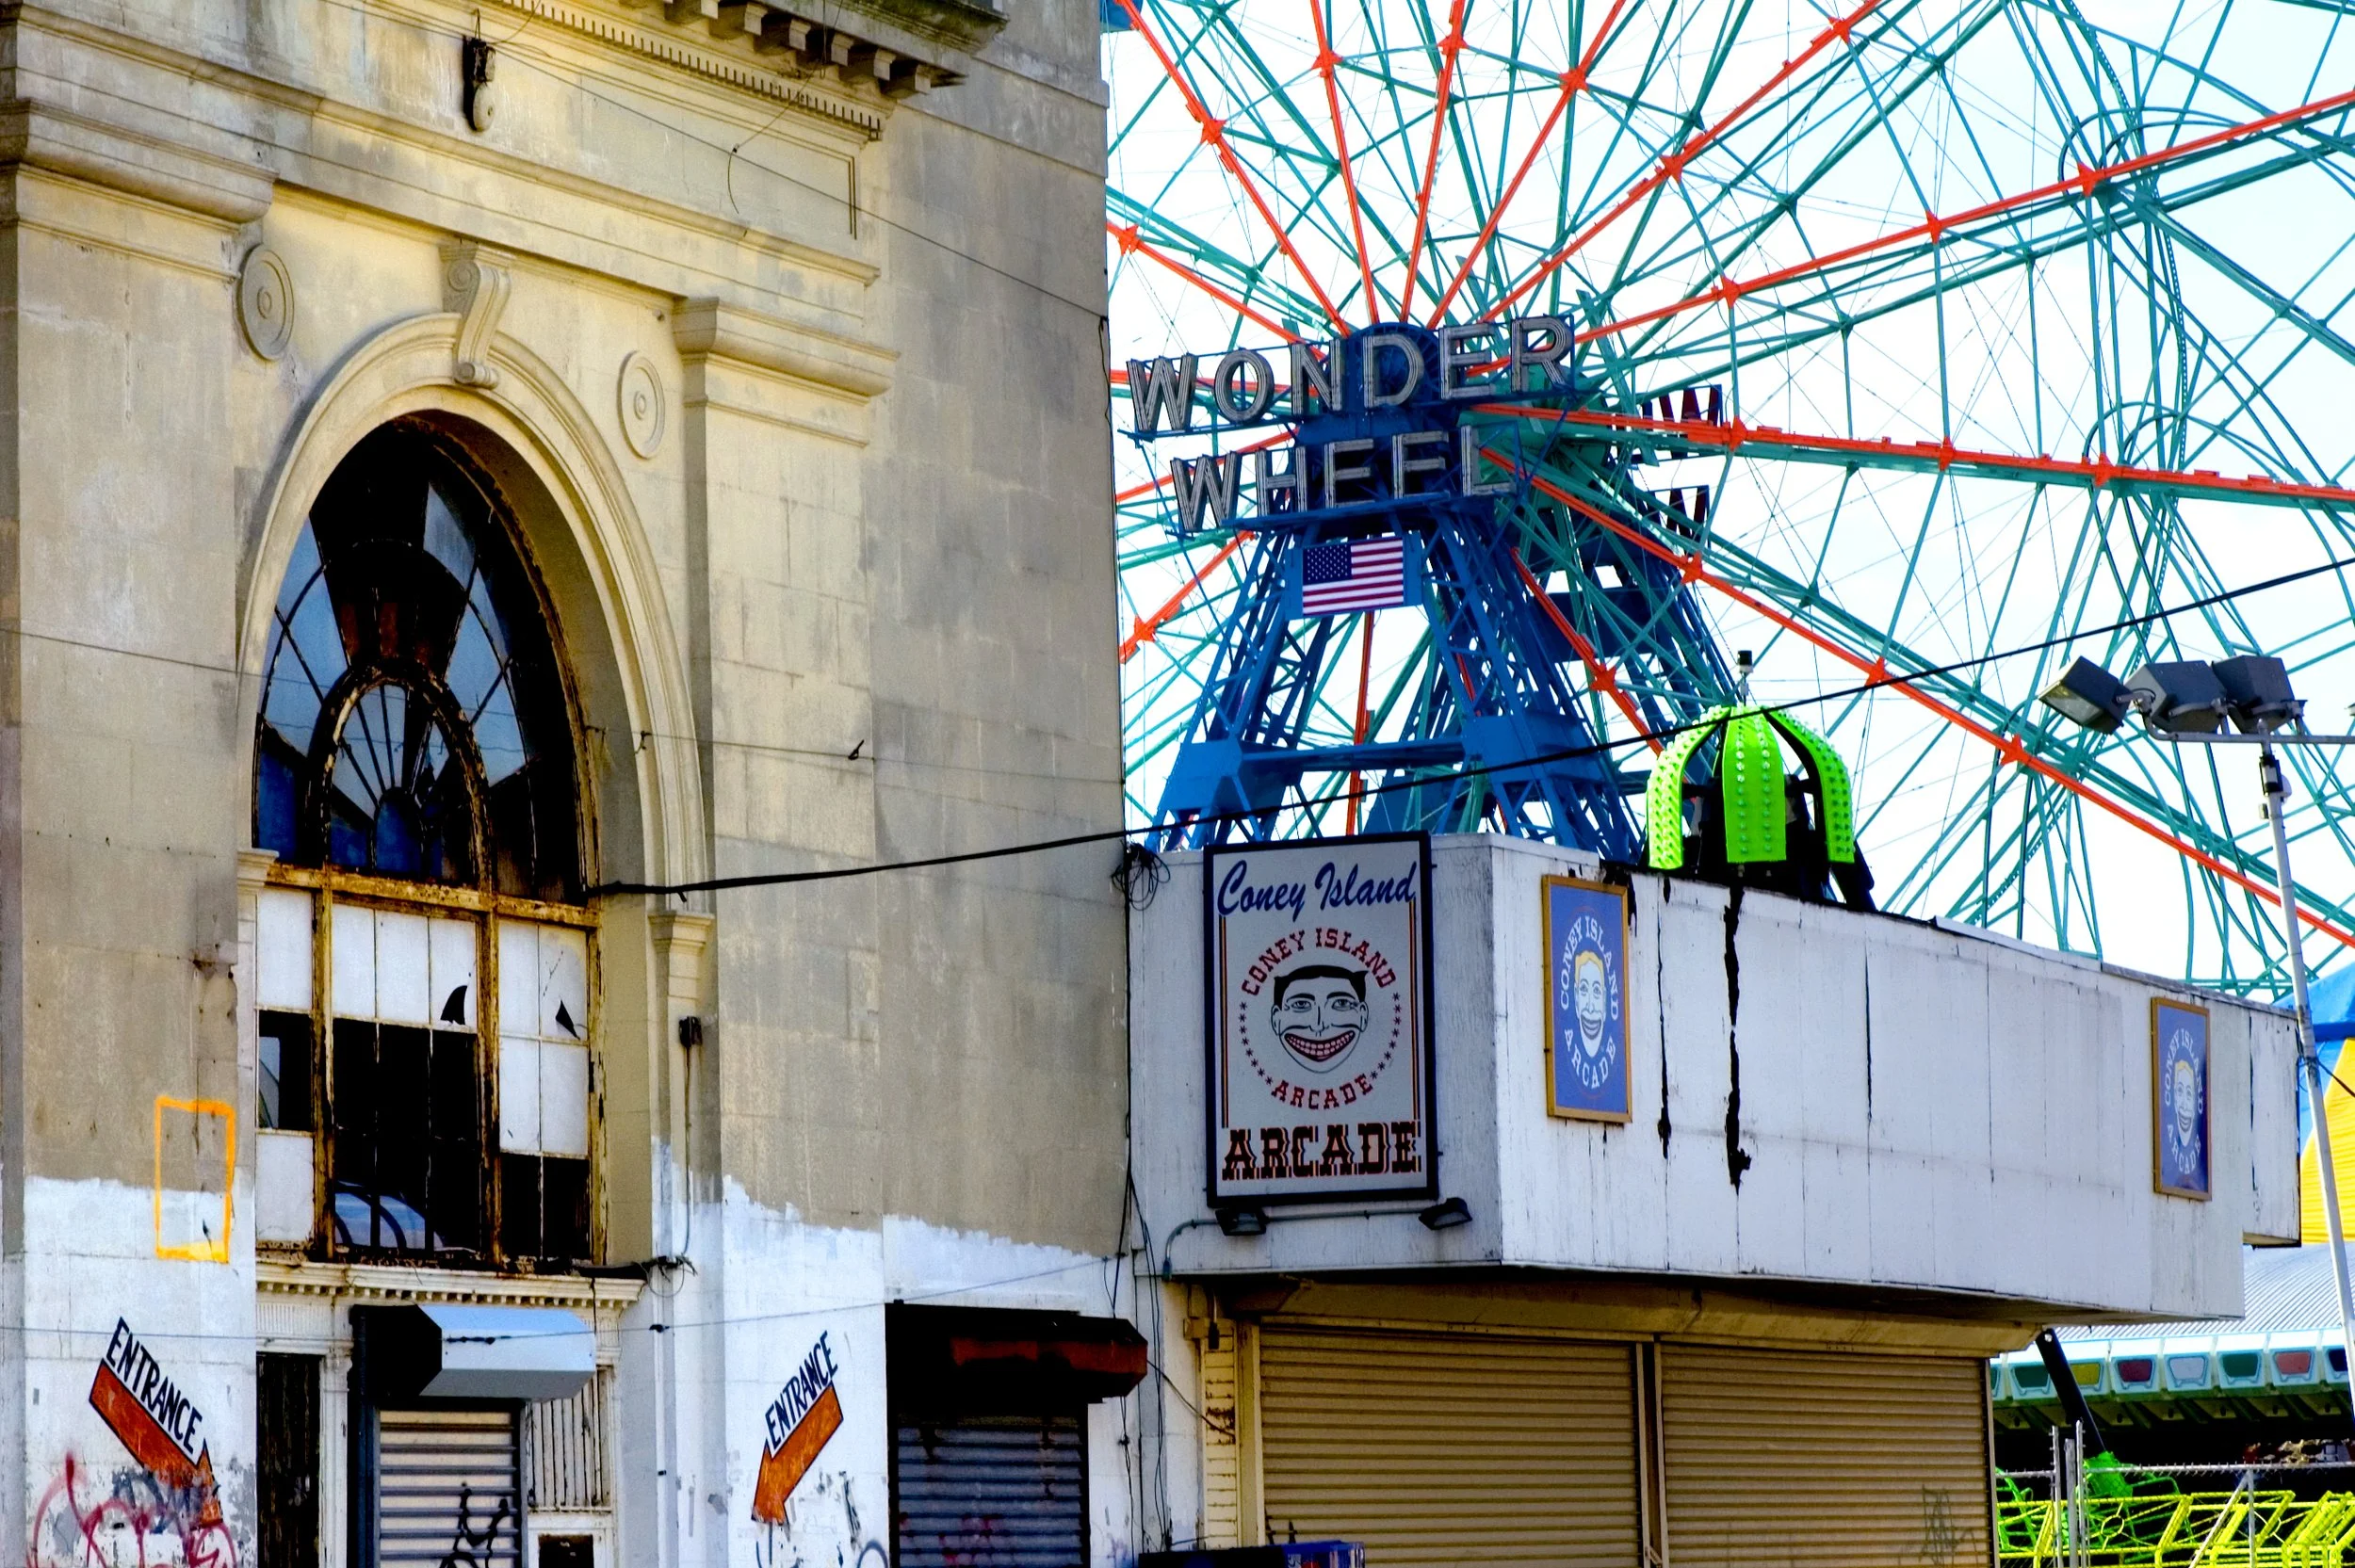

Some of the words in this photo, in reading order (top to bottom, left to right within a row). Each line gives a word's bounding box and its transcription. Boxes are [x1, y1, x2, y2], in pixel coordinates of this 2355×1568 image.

[1126, 316, 1574, 433] WONDER
[1170, 425, 1519, 532] WHEEL
[1217, 860, 1307, 922] Coney
[1314, 861, 1417, 911] Island
[1241, 929, 1306, 996] CONEY
[1315, 927, 1398, 990] ISLAND
[1560, 916, 1584, 1010] CONEY
[1585, 915, 1619, 1021] ISLAND
[1270, 1073, 1373, 1110] ARCADE
[1564, 1027, 1616, 1090] ARCADE
[2165, 1029, 2180, 1106] CONEY
[2181, 1027, 2203, 1115] ISLAND
[1222, 1122, 1421, 1181] ARCADE
[2167, 1123, 2201, 1175] ARCADE
[106, 1316, 203, 1454] ENTRANCE
[764, 1330, 838, 1450] ENTRANCE
